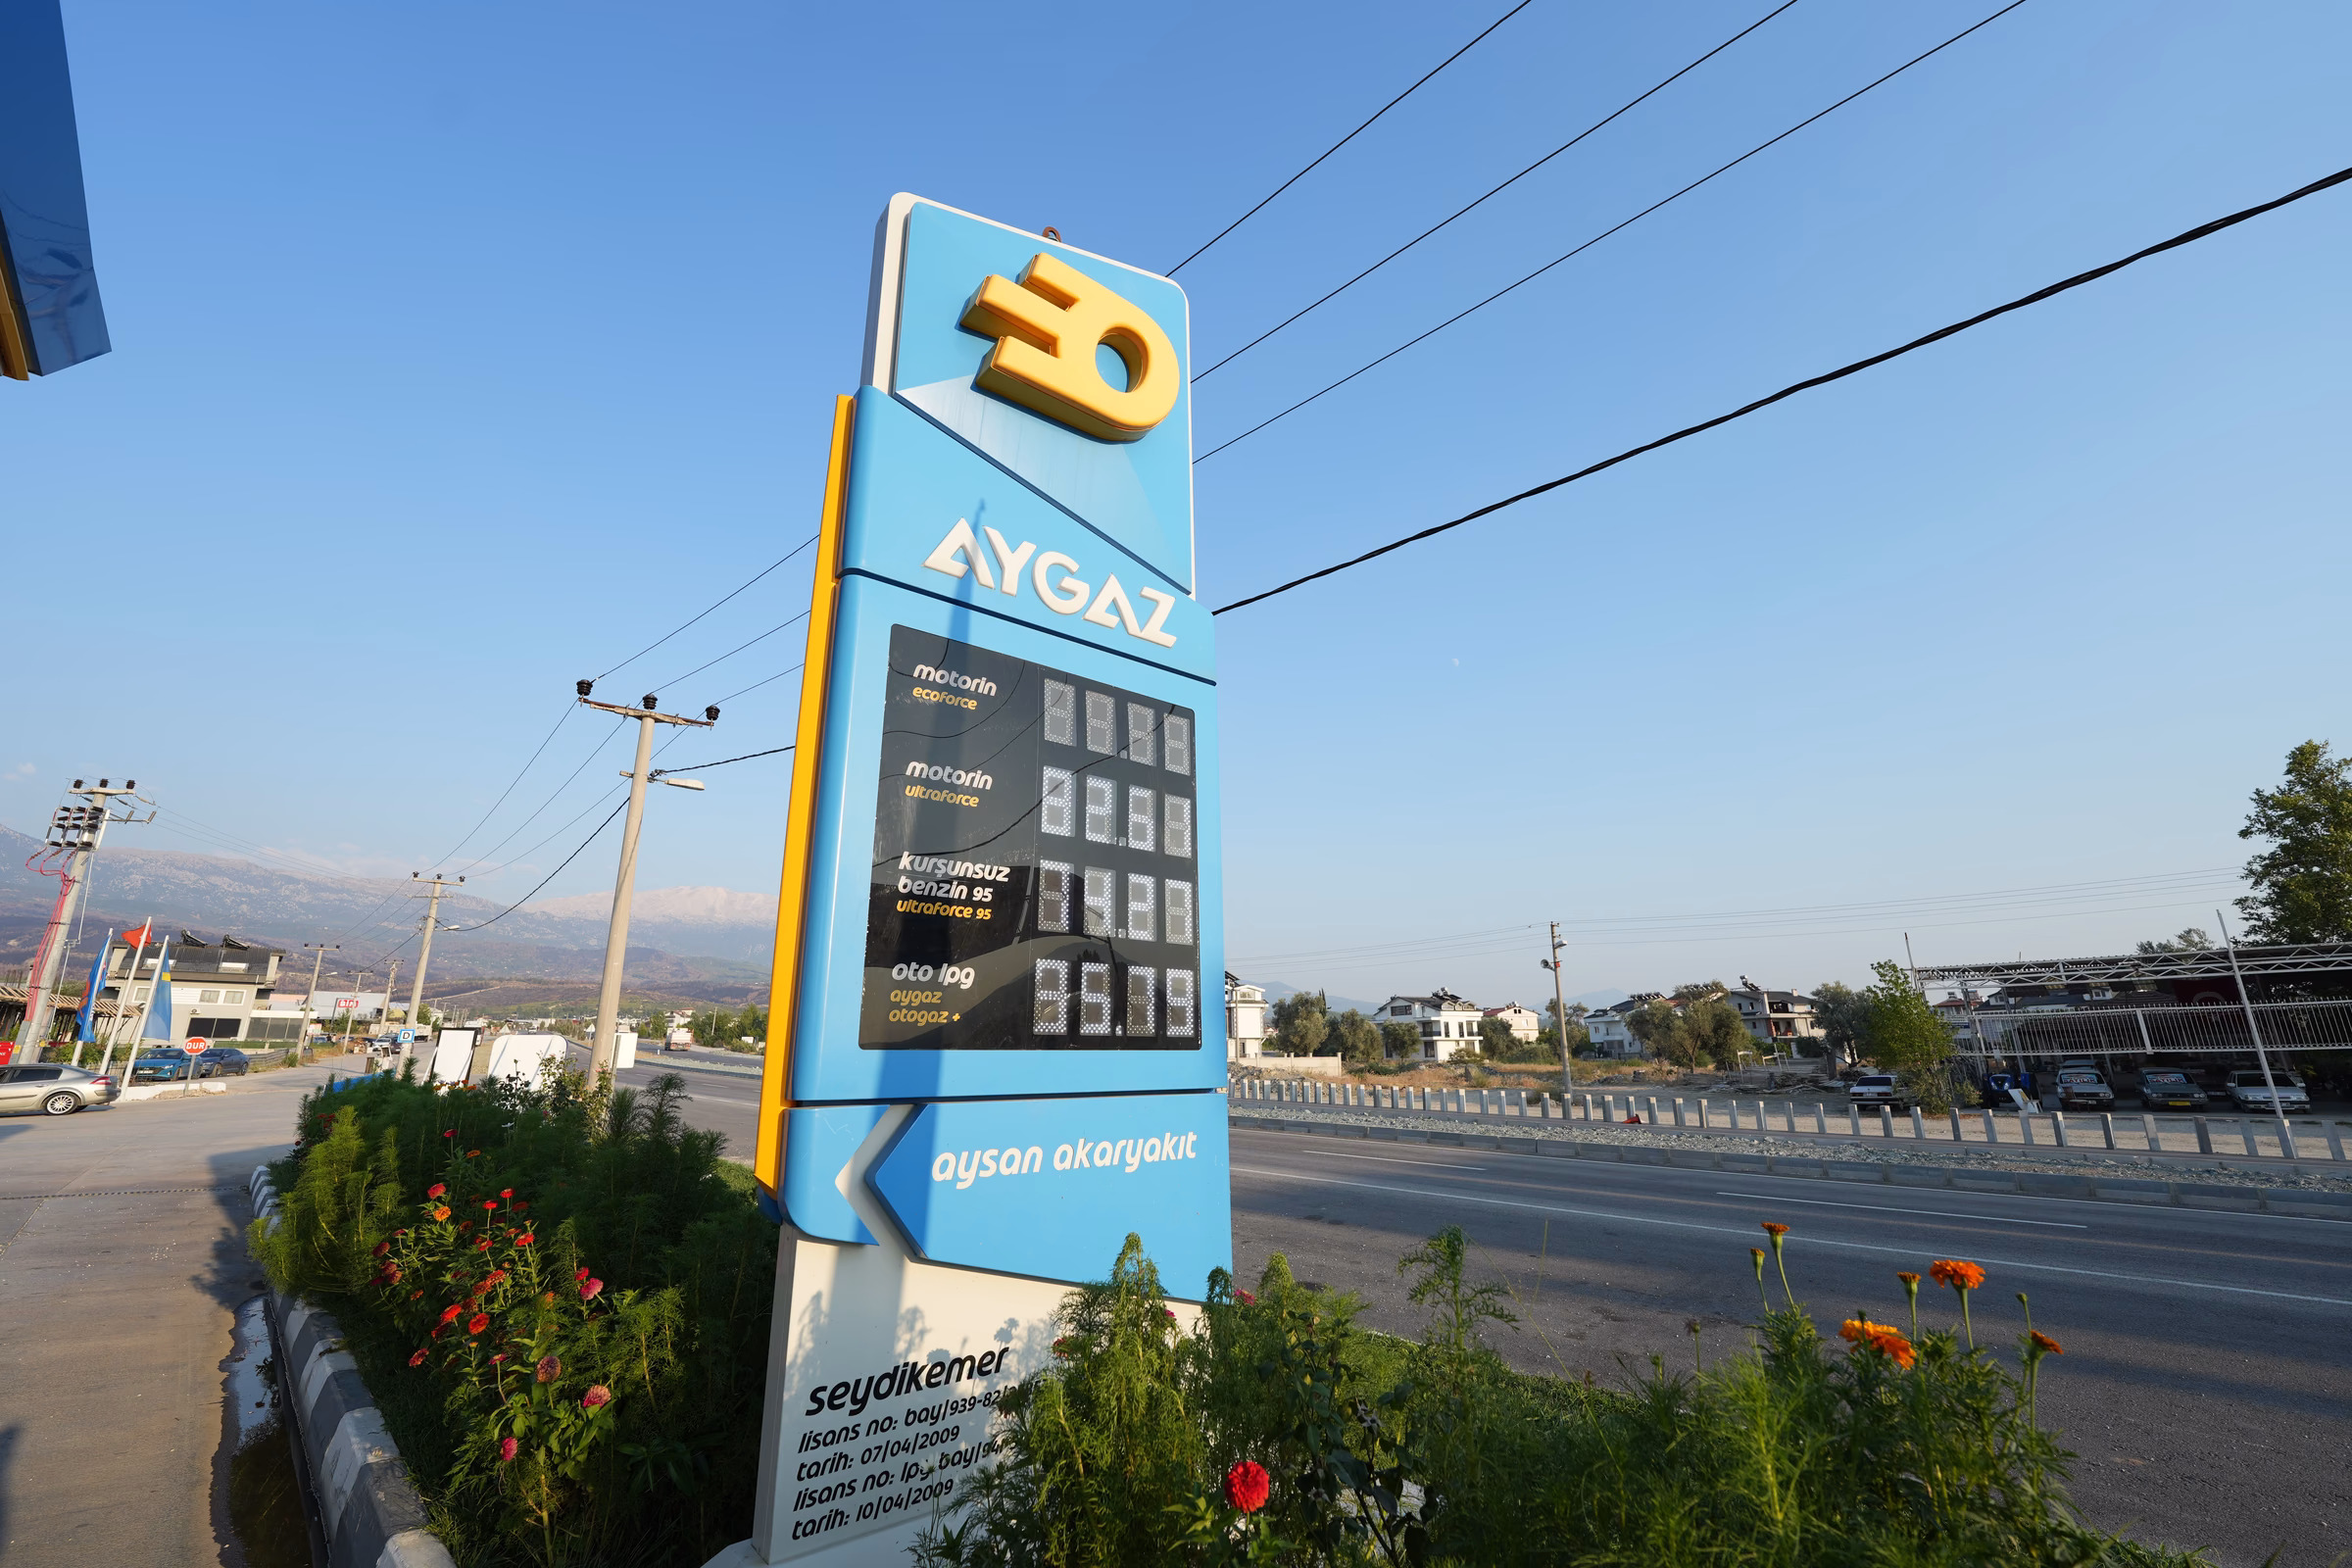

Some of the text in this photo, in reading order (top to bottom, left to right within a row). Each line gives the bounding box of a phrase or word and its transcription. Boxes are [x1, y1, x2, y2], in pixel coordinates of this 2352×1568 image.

[920, 516, 1177, 649] AYGAZ
[912, 663, 998, 697] motorin
[912, 686, 978, 710] ecoforce
[905, 760, 993, 790] motorin
[905, 784, 980, 808] ultraforce
[898, 851, 1011, 882] kurşunsuz
[898, 875, 994, 902] benzin 95
[896, 899, 992, 920] ultraforce 95
[892, 961, 975, 990] oto lpg
[890, 989, 943, 1006] aygaz
[889, 1008, 950, 1026] otogaz
[931, 1131, 1198, 1190] aysan akaryakıt
[805, 1347, 1009, 1416] seydikemer
[797, 1423, 861, 1453] lisans
[865, 1415, 898, 1437] no:
[797, 1425, 960, 1482] tarih: 07/04/2009
[793, 1478, 858, 1512] lisans
[861, 1470, 895, 1493] no:
[792, 1478, 954, 1541] tarih: 10/04/2009
